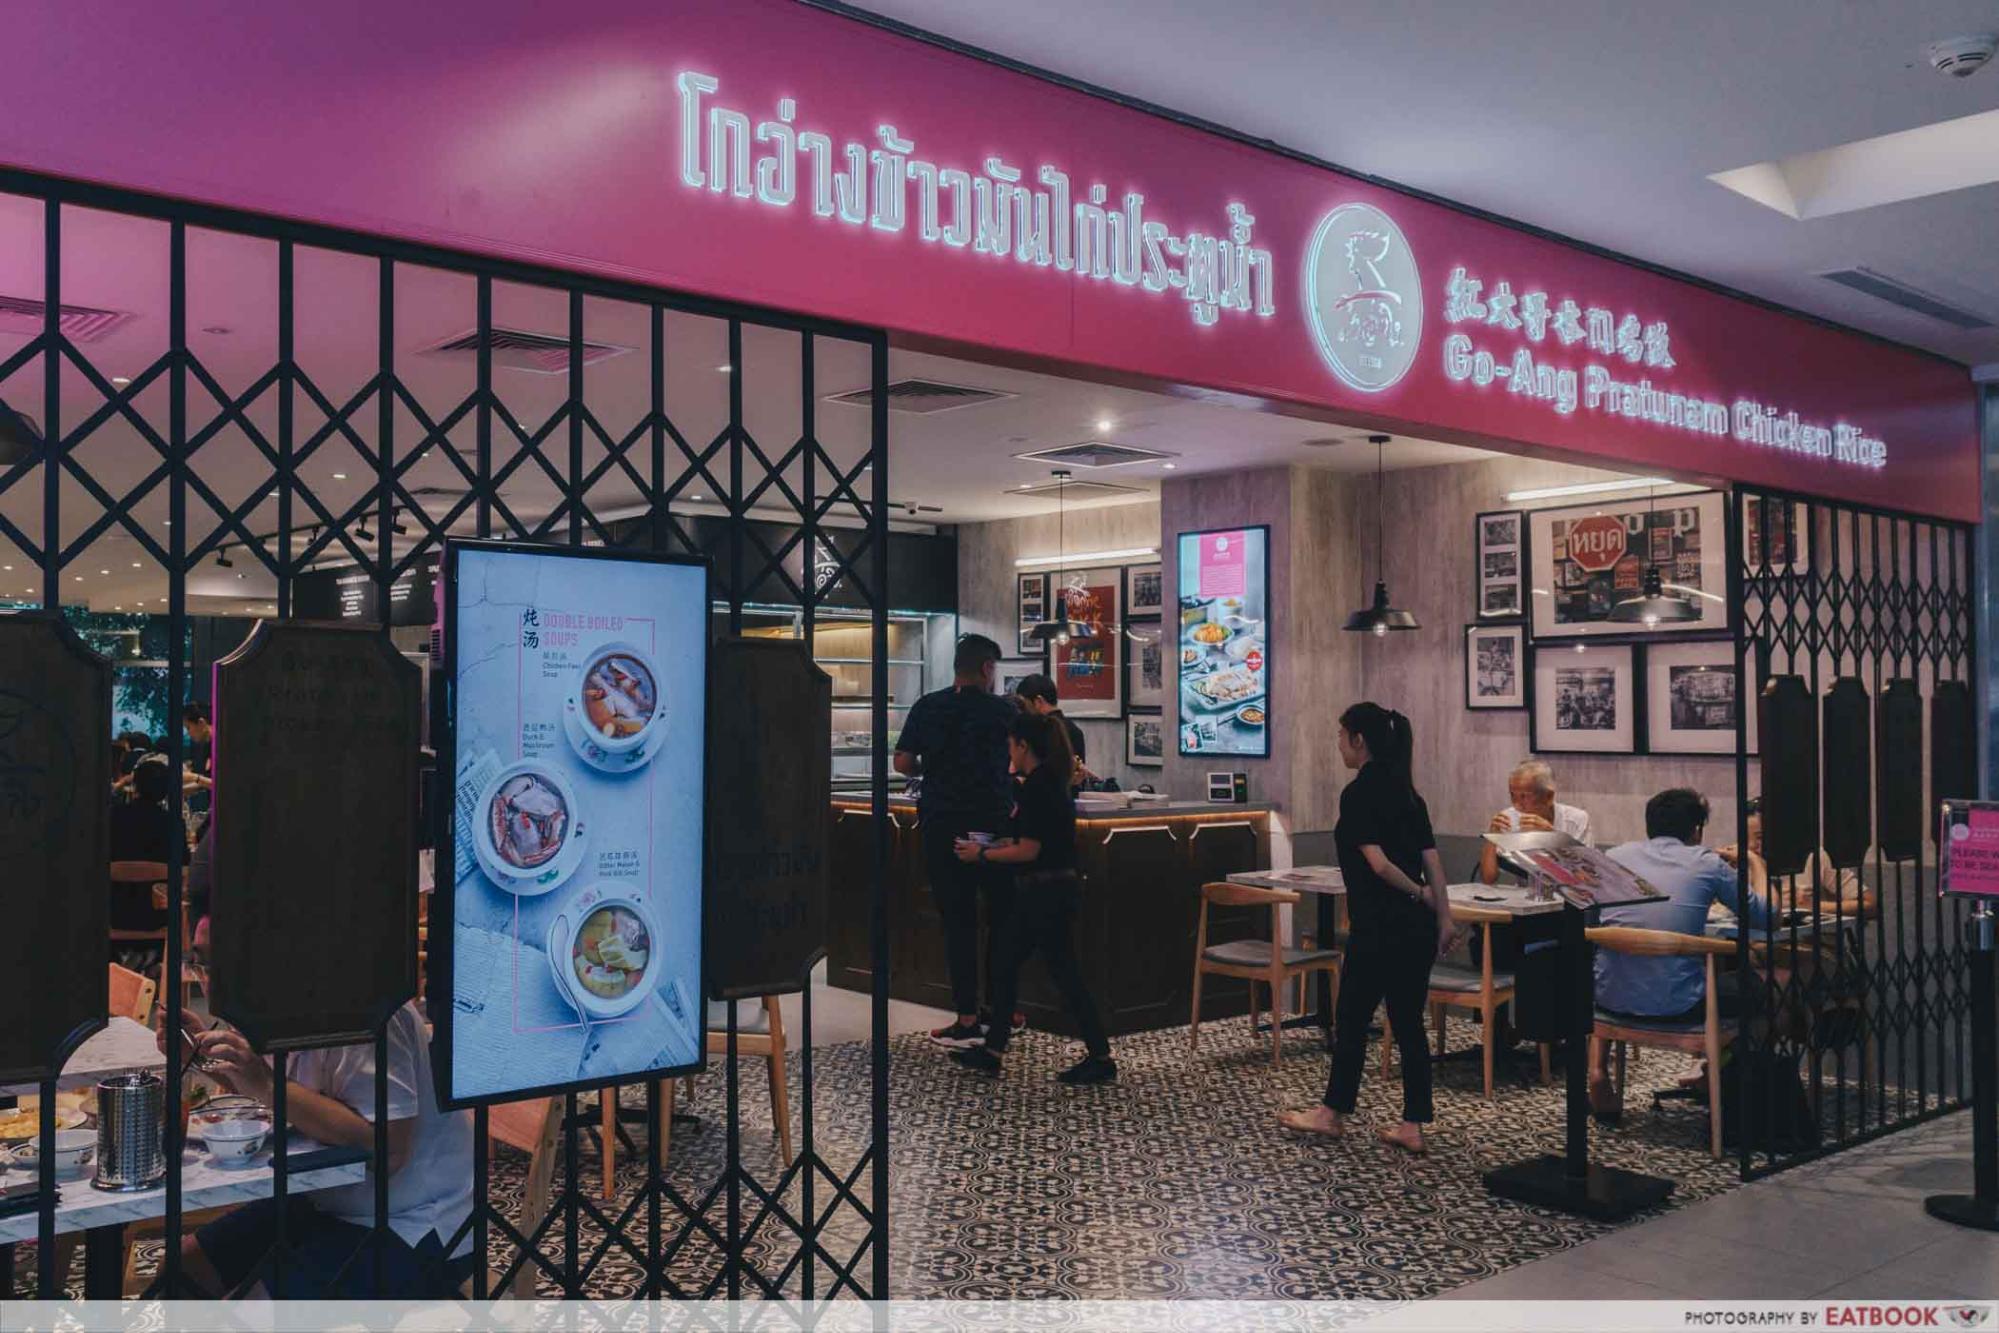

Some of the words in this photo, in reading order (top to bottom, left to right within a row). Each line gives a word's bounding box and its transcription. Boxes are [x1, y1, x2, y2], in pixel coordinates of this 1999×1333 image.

[1445, 334, 1578, 413] Go-Ang
[1584, 366, 1729, 436] Pratunam
[1731, 399, 1832, 458] Chicken
[1832, 422, 1887, 468] Rice
[1573, 529, 1621, 562] หยุด
[544, 614, 586, 630] DOUBLE
[587, 616, 624, 632] BOILED
[543, 631, 579, 647] SOUPS
